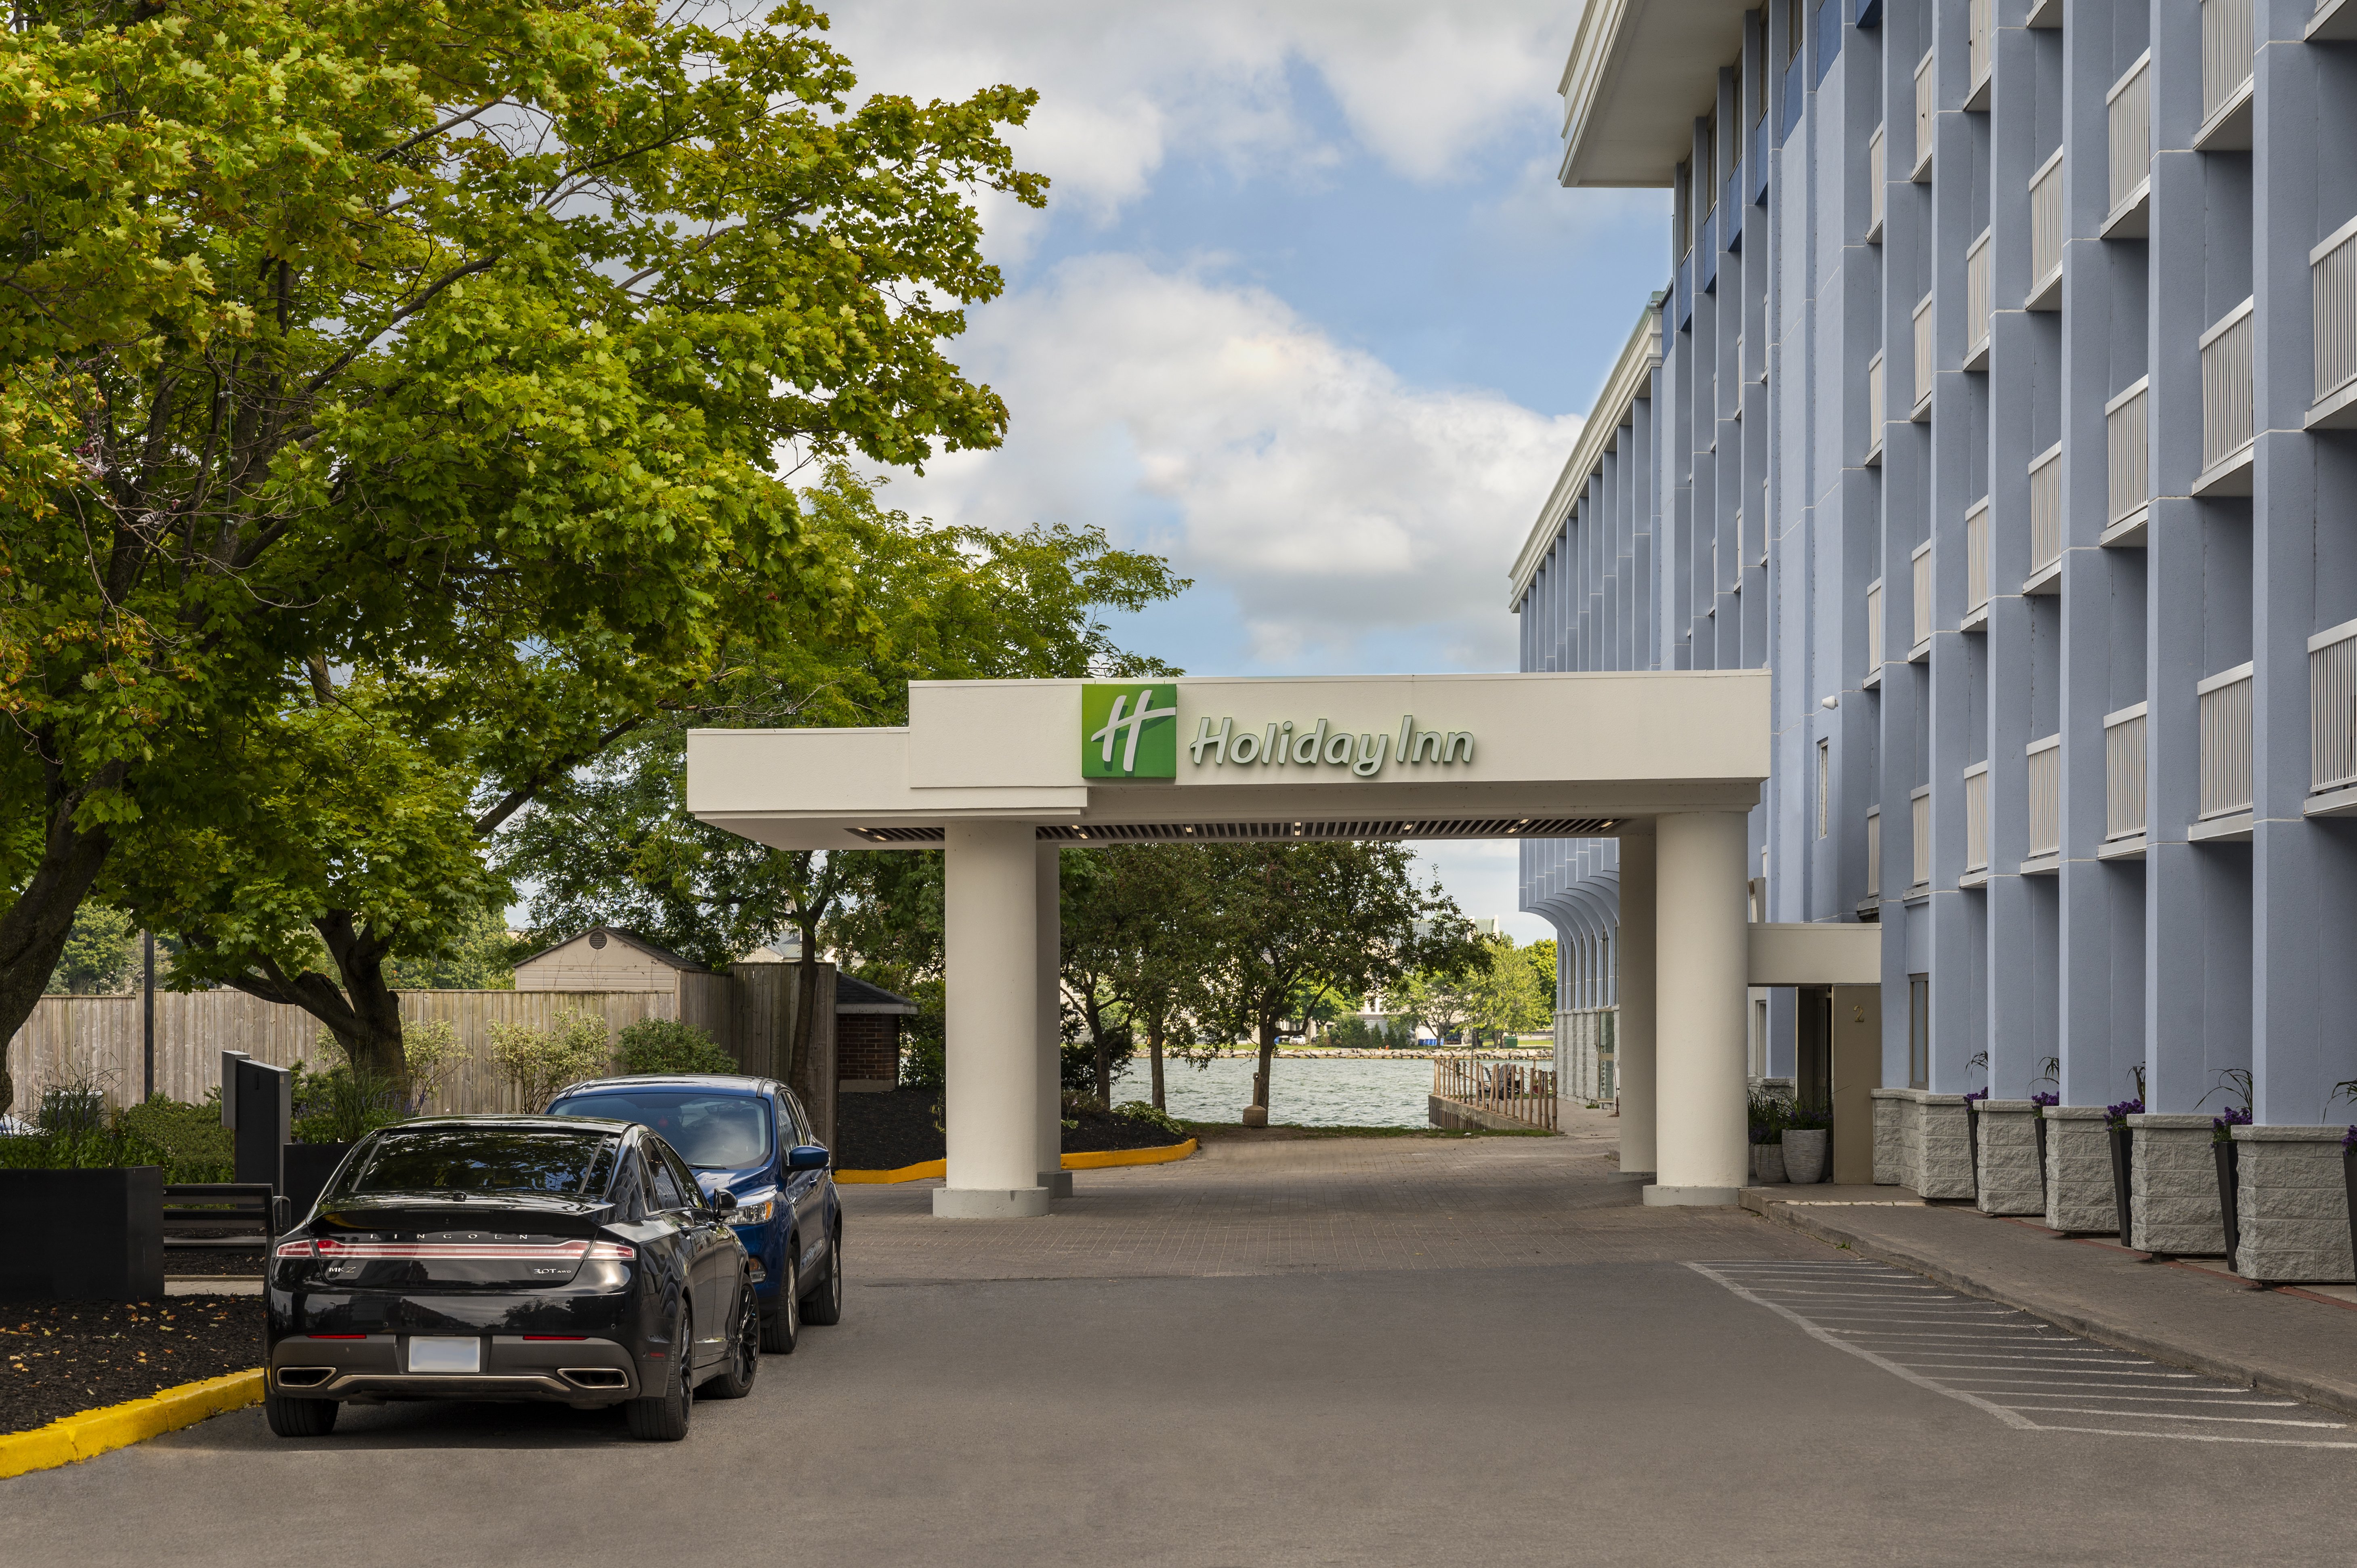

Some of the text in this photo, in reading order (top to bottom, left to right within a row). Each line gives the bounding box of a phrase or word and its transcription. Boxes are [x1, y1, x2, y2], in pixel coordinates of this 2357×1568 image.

[1091, 690, 1176, 771] H
[1190, 715, 1473, 776] Holiday Inn
[1853, 1005, 1864, 1022] 2
